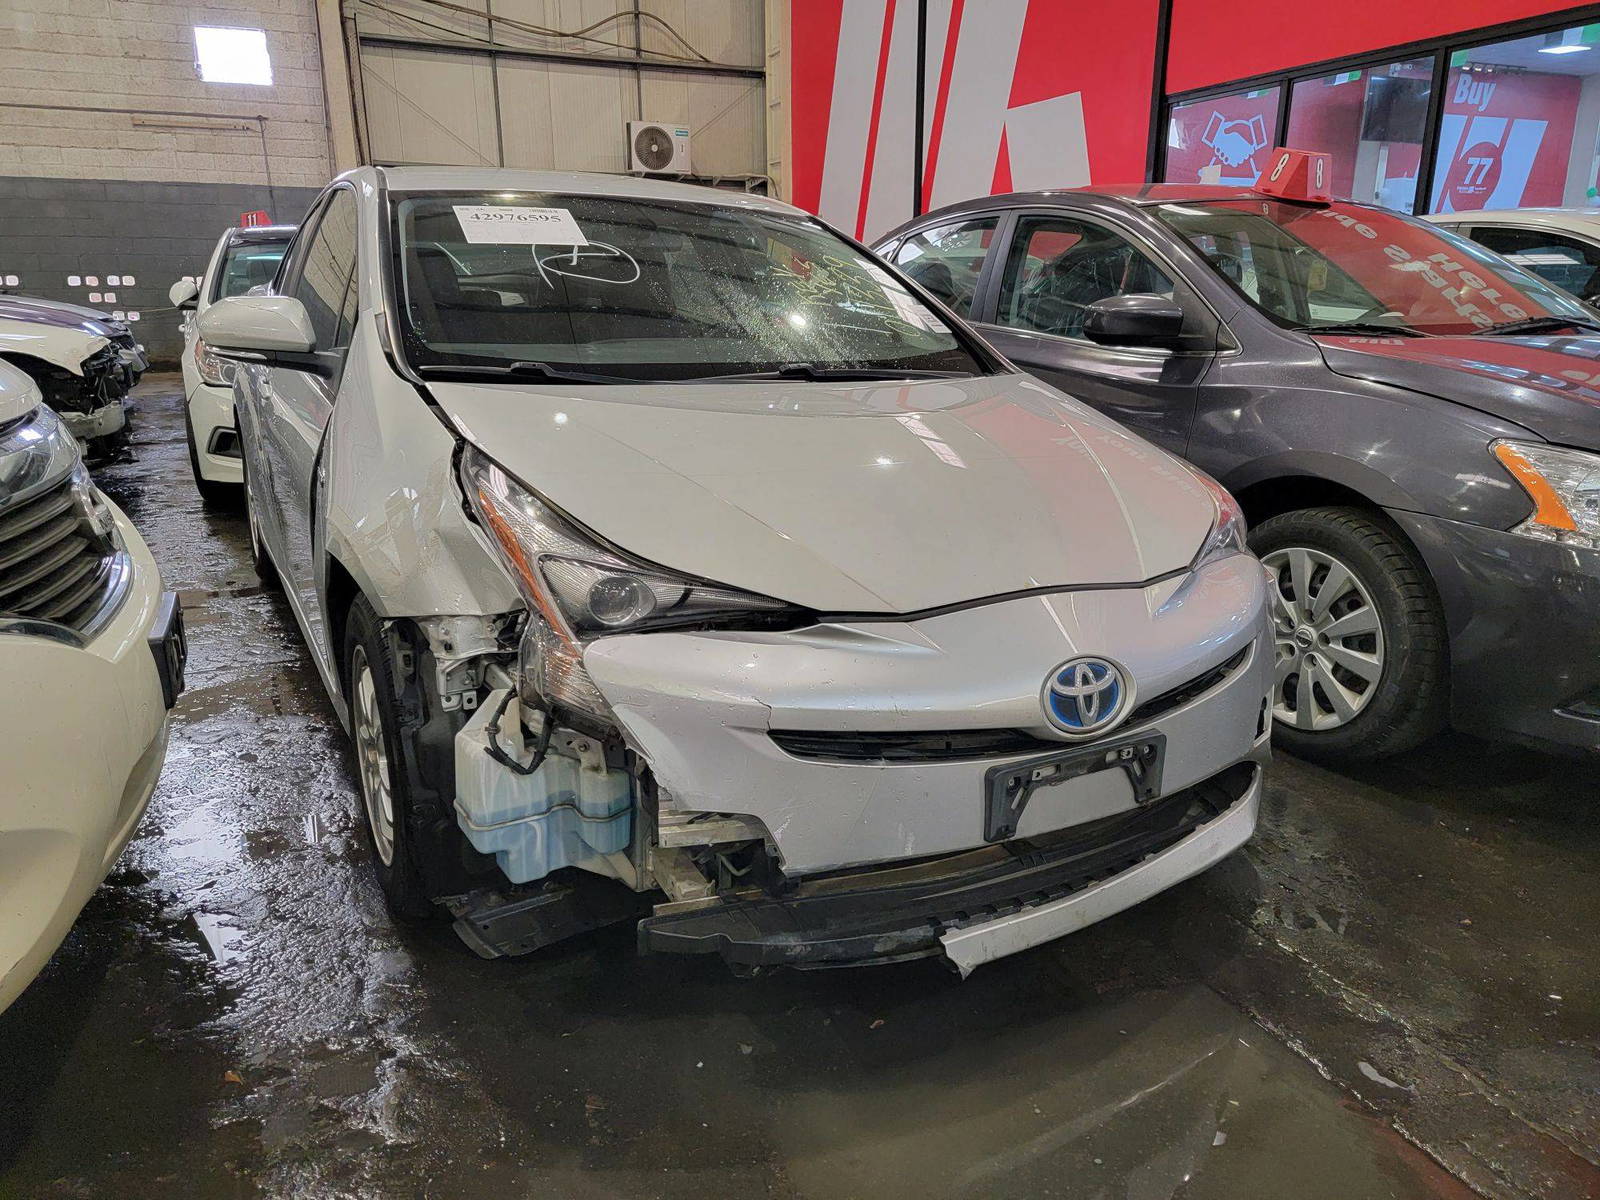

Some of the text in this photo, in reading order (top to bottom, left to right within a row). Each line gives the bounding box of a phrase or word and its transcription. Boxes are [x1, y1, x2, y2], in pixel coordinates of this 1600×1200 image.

[1453, 72, 1496, 112] Buy
[1270, 153, 1290, 182] 8
[1315, 158, 1324, 189] 8
[1463, 157, 1494, 185] 77
[247, 213, 257, 227] 11
[470, 213, 562, 223] 42976595
